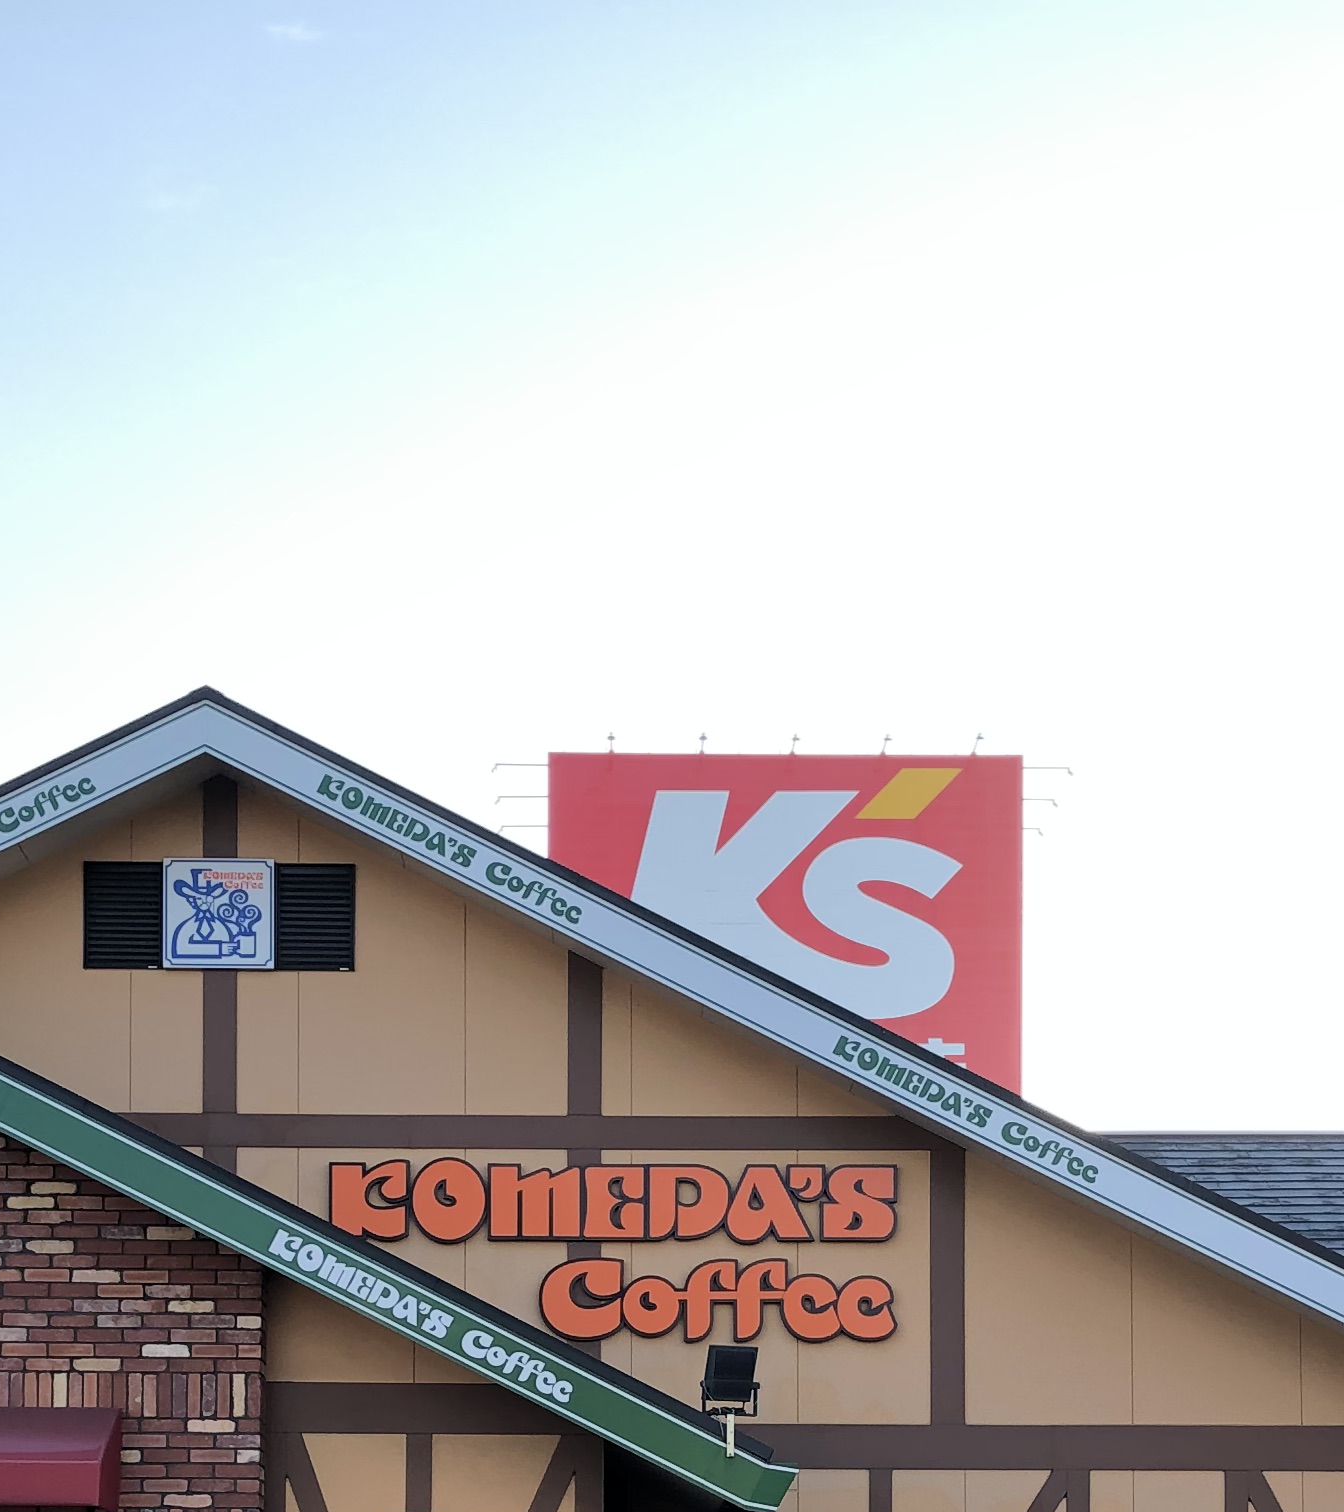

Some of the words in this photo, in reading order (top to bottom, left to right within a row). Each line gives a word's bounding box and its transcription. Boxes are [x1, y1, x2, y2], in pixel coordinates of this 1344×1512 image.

[316, 774, 477, 869] KOMEDA'S
[486, 862, 582, 925] Coffee
[833, 1034, 992, 1130] KOMEDA'S
[1001, 1120, 1098, 1185] Coffee
[328, 1157, 898, 1245] KOMEDA'S
[268, 1228, 453, 1339] KOMEDA'S
[461, 1329, 574, 1403] Coffee
[539, 1258, 898, 1342] Coffee
